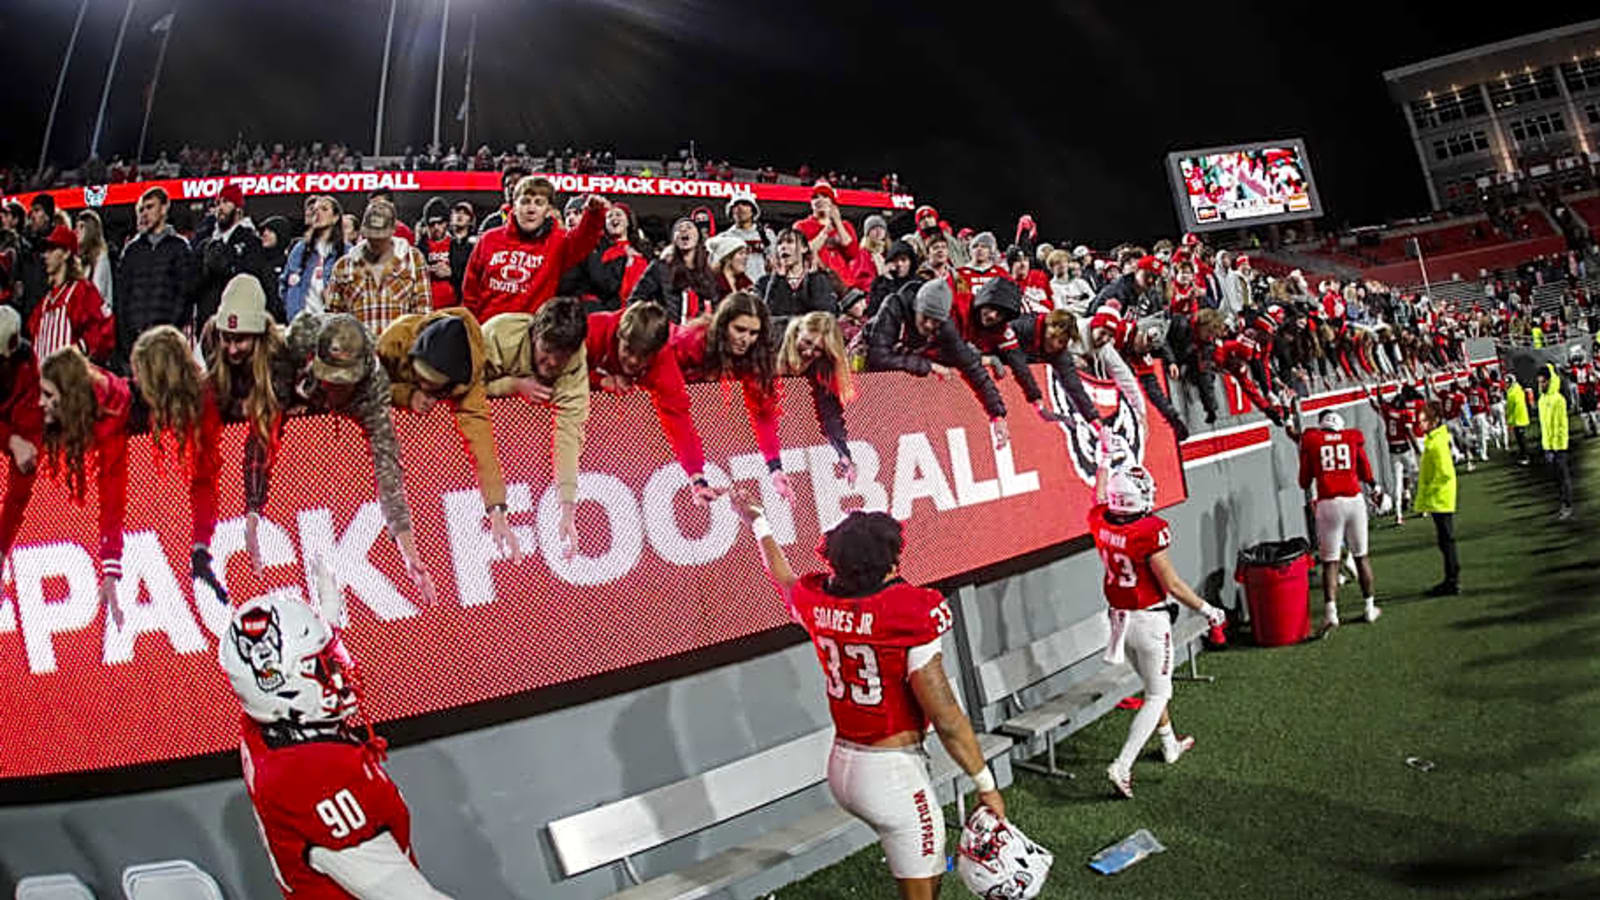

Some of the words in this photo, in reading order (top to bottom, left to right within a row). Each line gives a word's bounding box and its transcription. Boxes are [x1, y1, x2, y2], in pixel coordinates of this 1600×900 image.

[304, 173, 420, 192] FOOTBALL
[1320, 443, 1351, 472] 89
[0, 501, 421, 675] PACK
[443, 426, 1040, 608] FOOTBALL
[812, 606, 854, 633] SOARES
[856, 612, 874, 636] JR
[817, 635, 883, 706] 33
[316, 788, 367, 838] 90
[912, 788, 935, 858] WOLFPACK
